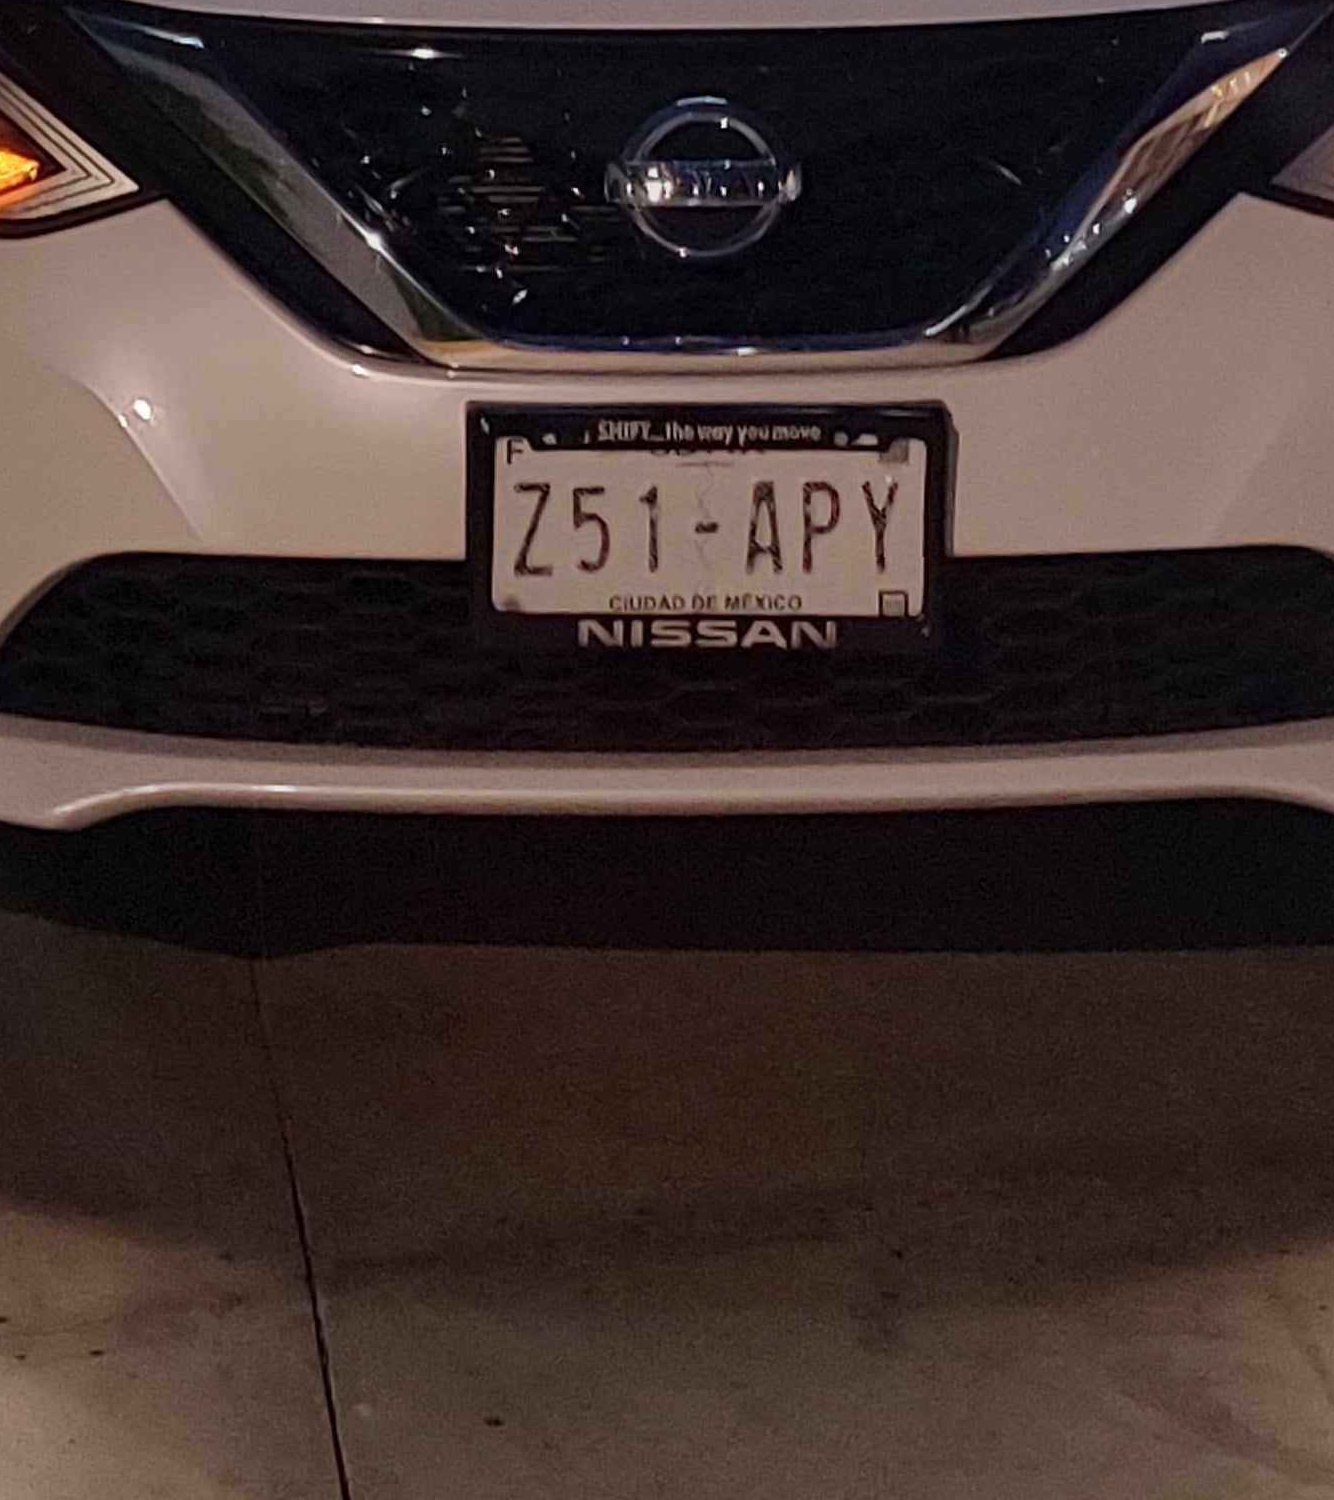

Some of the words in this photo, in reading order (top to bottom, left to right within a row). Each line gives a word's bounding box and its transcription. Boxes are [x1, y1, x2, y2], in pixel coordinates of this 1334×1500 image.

[697, 424, 734, 446] way
[736, 424, 769, 447] you
[772, 425, 822, 442] move
[513, 480, 899, 577] Z51-APY
[609, 595, 686, 612] CIUDAD
[691, 594, 716, 611] DE
[577, 618, 837, 649] NISSAN
